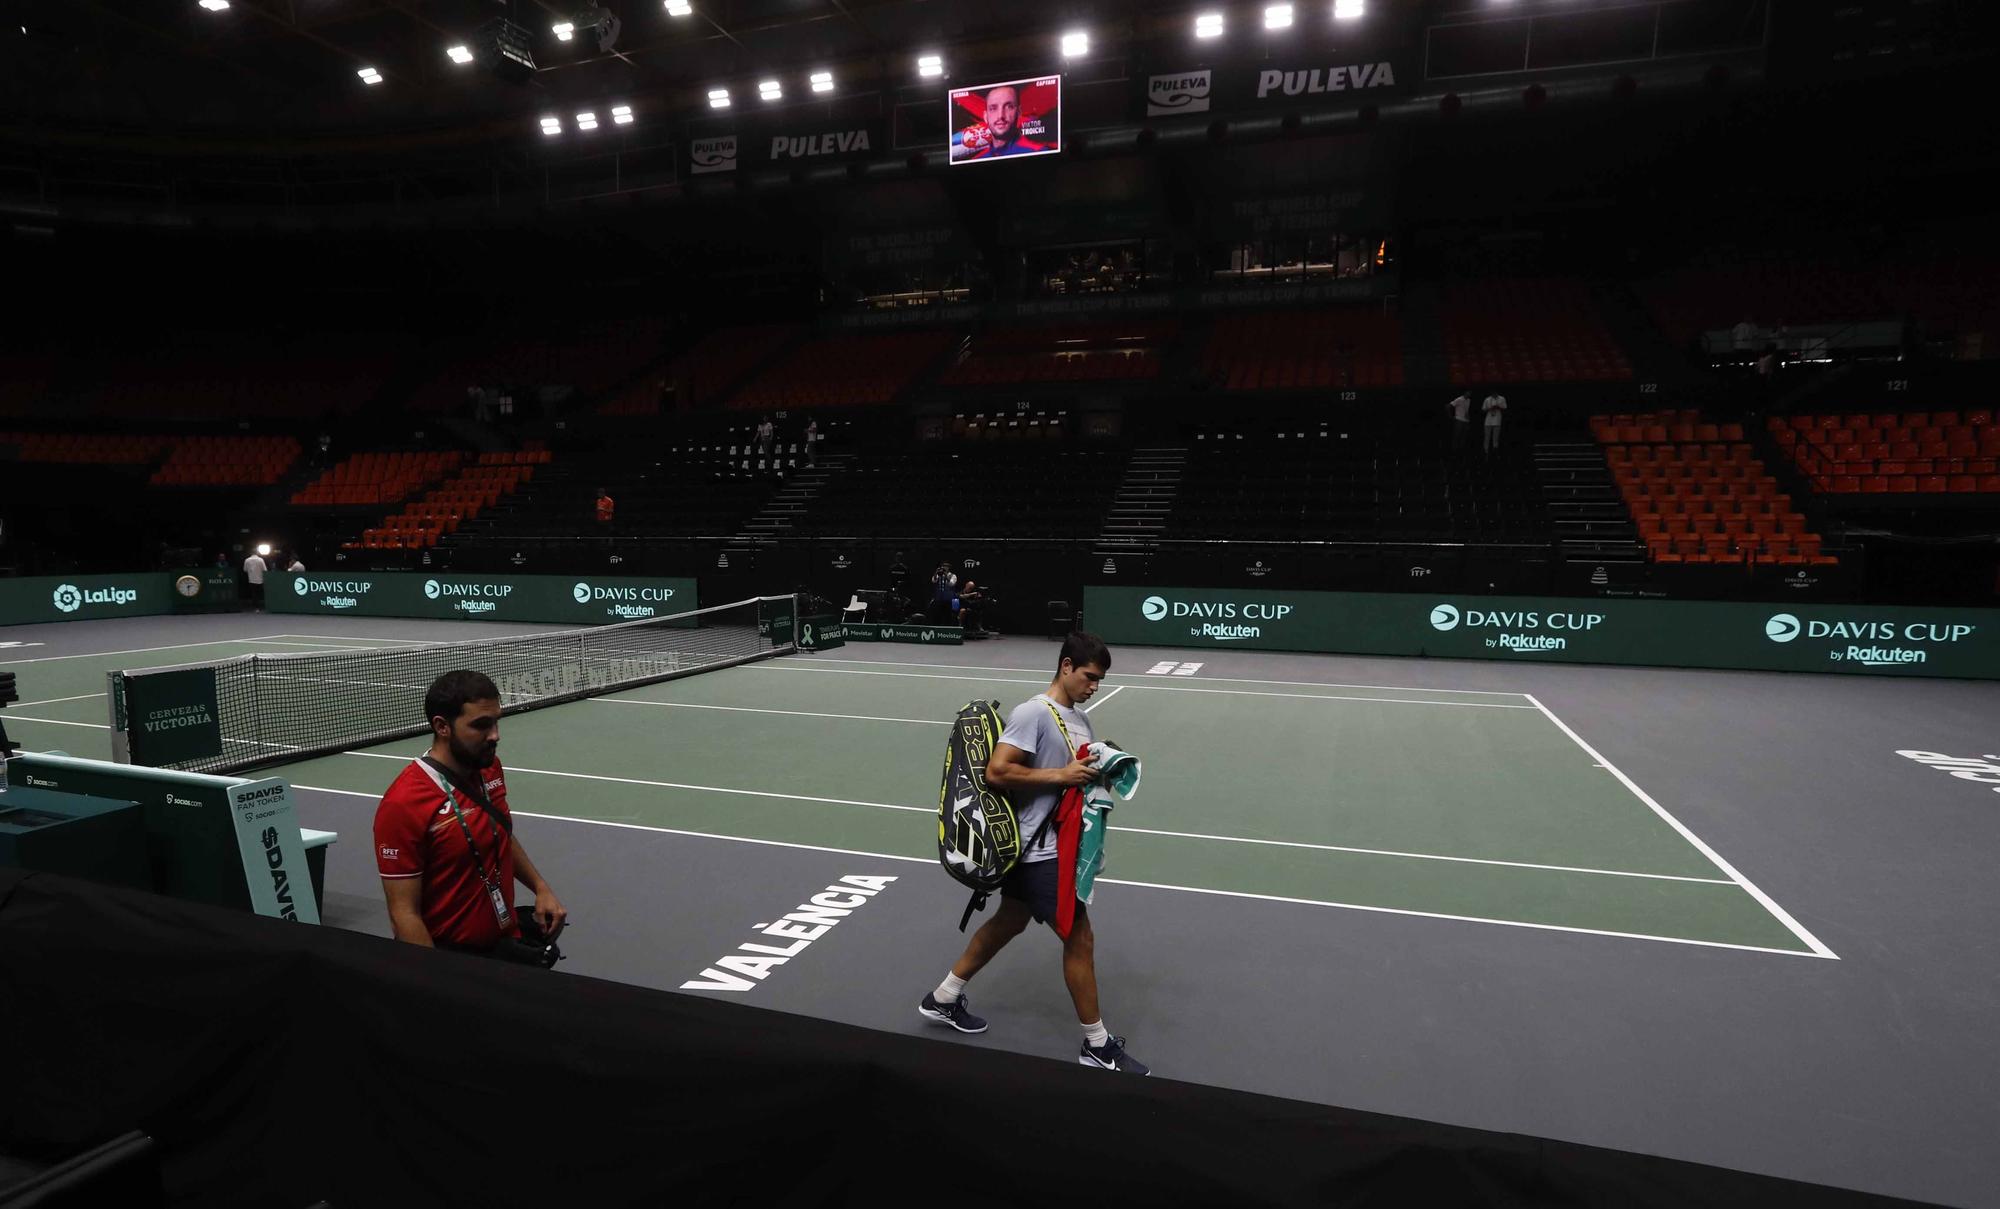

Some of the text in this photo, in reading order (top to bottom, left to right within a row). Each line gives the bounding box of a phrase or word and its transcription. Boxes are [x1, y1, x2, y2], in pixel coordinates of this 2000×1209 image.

[1152, 76, 1207, 93] PULEVA
[1257, 61, 1395, 98] PULEVA
[694, 141, 734, 154] PULEVA
[770, 130, 870, 160] PULEVA
[1639, 383, 1658, 393] 122
[1886, 380, 1908, 391] 121
[1341, 391, 1356, 401] 123
[1016, 401, 1030, 410] 124
[310, 582, 371, 594] DAVIS CUP
[443, 584, 512, 597] DAVIS CUP
[594, 587, 674, 601] DAVIS CUP
[84, 586, 137, 605] LaLiga
[320, 596, 357, 608] by Rakuten
[454, 600, 496, 613] by Rakuten
[607, 604, 654, 618] by Rakuten
[1173, 602, 1291, 620] DAVIS CUP
[1466, 610, 1602, 630] DAVIS CUP
[850, 629, 873, 637] Movistar
[937, 632, 962, 640] Movistar
[1191, 623, 1260, 640] by Rakuten
[1808, 620, 1972, 642] DAVIS CUP
[1486, 633, 1566, 652] by Rakuten
[1830, 645, 1926, 666] by Rakuten
[149, 704, 206, 719] CERVEZAS
[144, 713, 212, 732] VICTORIA
[237, 794, 285, 811] FAN TOKEN
[383, 847, 399, 856] RFET
[679, 874, 900, 992] VALÈNCIA
